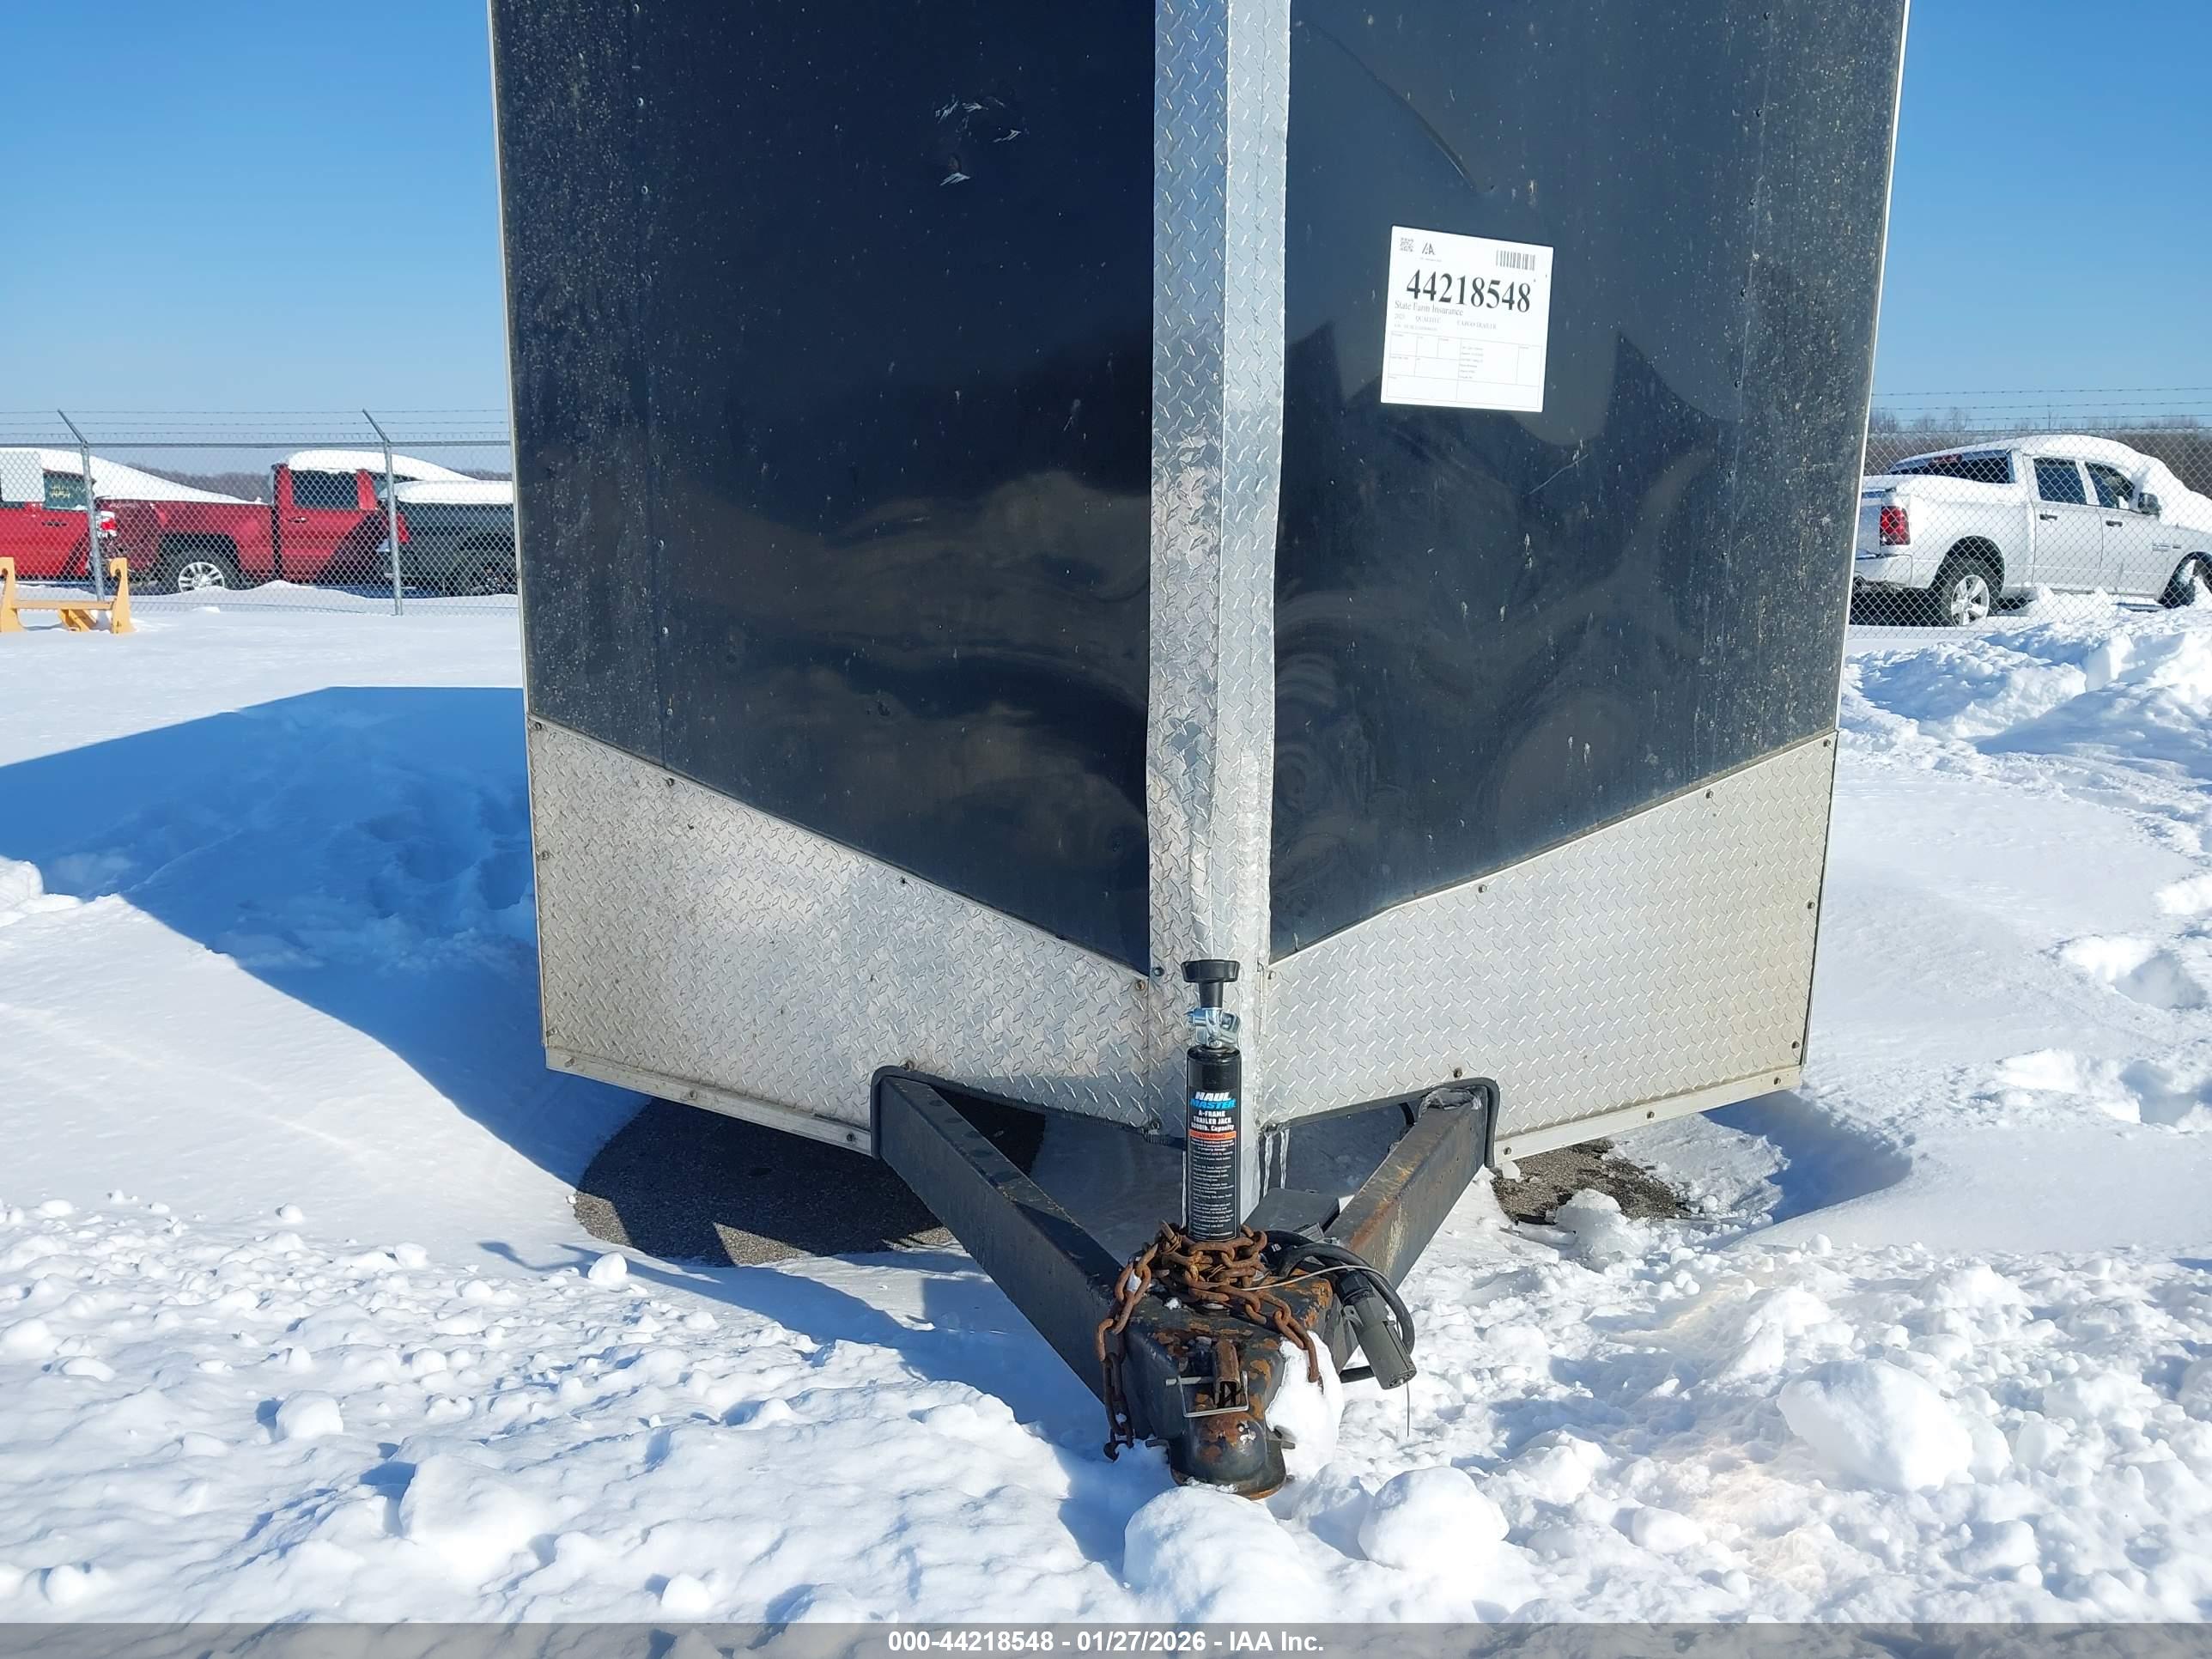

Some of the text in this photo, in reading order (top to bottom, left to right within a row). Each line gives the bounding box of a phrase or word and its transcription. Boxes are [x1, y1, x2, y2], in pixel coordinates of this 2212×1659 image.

[1406, 269, 1531, 313] 44218548
[1395, 300, 1464, 316] State Farm Insurance
[1194, 1091, 1231, 1102] HAUL
[1190, 1098, 1237, 1109] MASTER
[1193, 1115, 1217, 1125] TRAILER
[1211, 1124, 1235, 1133] Capacity
